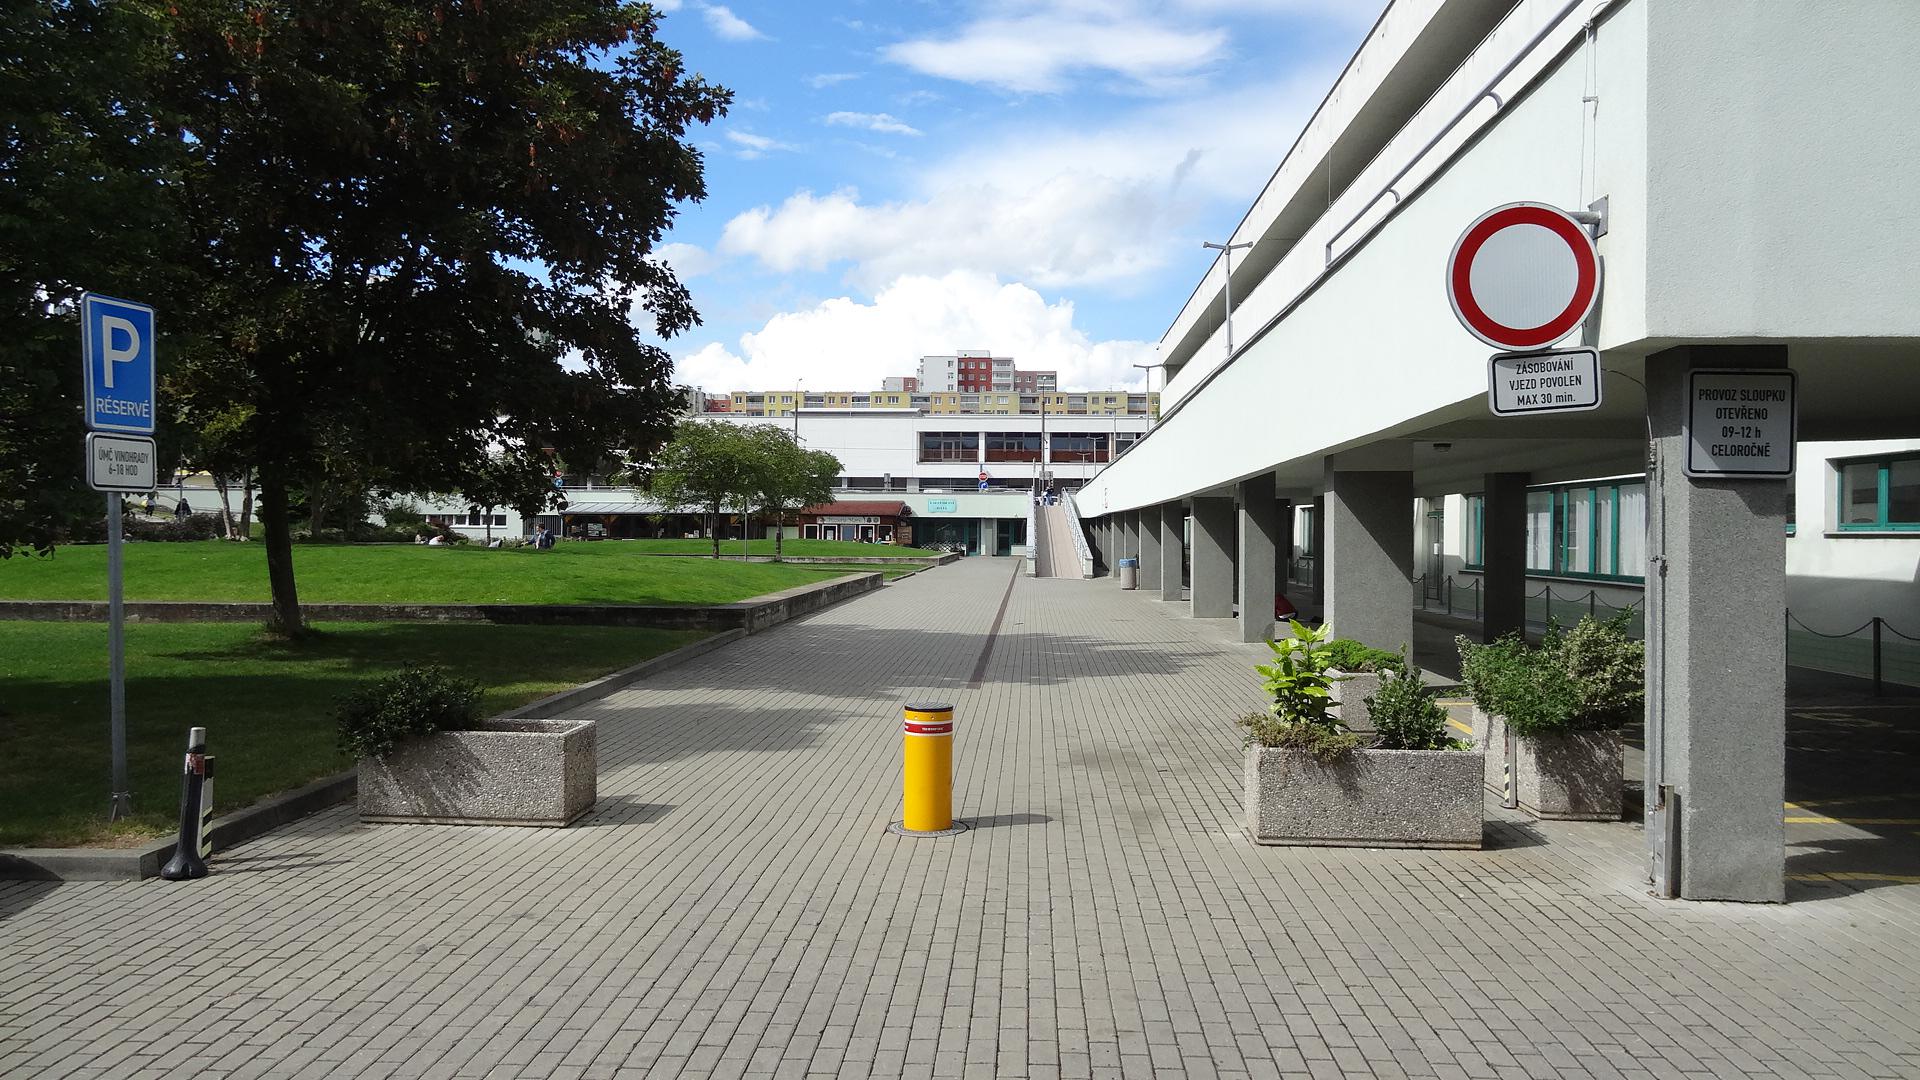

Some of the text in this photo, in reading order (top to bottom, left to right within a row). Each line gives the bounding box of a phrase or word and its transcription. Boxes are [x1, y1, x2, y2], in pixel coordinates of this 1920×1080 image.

[102, 315, 140, 388] P
[1516, 358, 1574, 374] ZÁSOBOVÁNÍ
[1509, 375, 1582, 390] VJEZD POVOLEN
[1517, 391, 1576, 406] MAX 30 min.
[1699, 388, 1786, 402] PROVOZ SLOUPKU
[96, 395, 150, 418] RÉSERVÉ
[1716, 405, 1768, 420] OTEVŘENO
[1755, 426, 1761, 438] h
[98, 446, 149, 464] ÚMČ VINOHRADY
[125, 464, 138, 476] HOD
